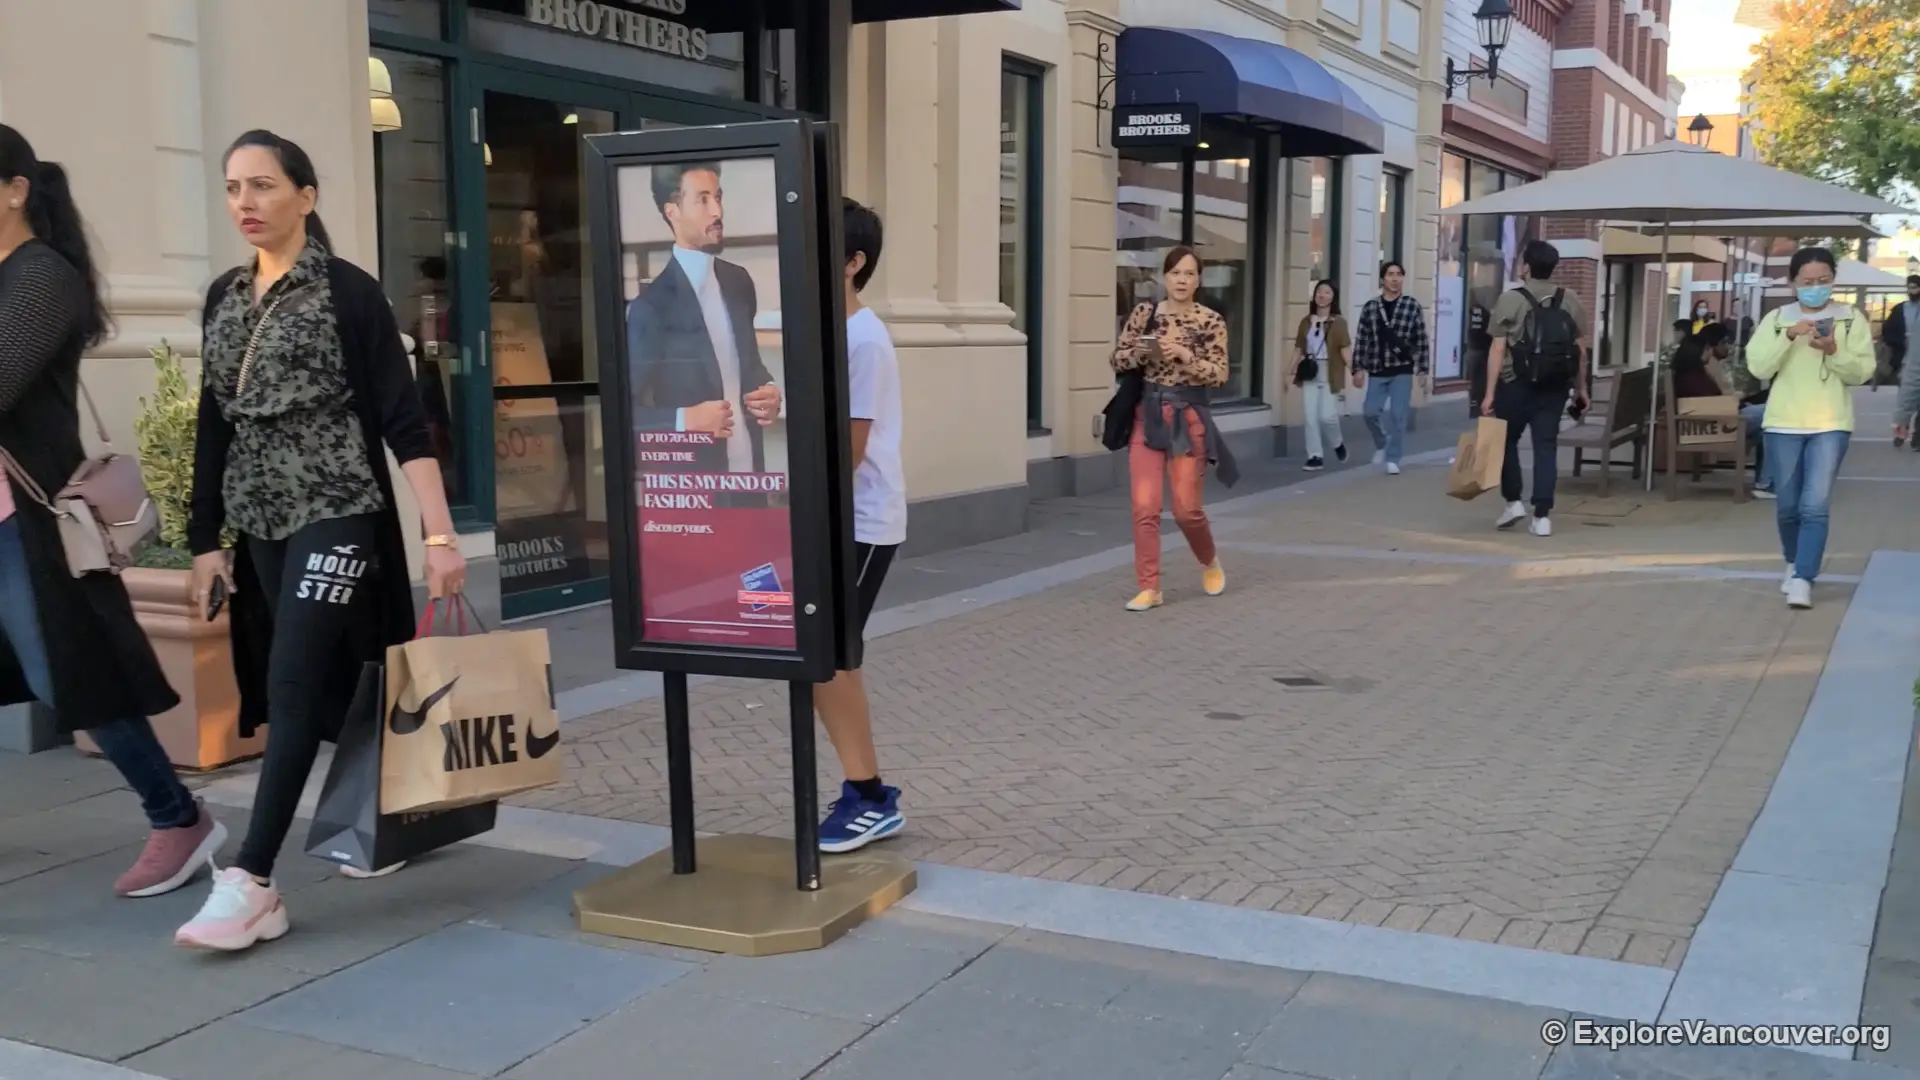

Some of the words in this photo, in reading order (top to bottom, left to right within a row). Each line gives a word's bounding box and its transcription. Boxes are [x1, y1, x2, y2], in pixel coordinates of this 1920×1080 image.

[527, 0, 707, 60] BROTHERS
[1128, 114, 1182, 125] BROOKS
[1119, 125, 1191, 136] BROTHERS
[1680, 420, 1718, 436] NIKE
[640, 432, 654, 443] UP
[653, 432, 669, 443] TO
[641, 451, 670, 462] EVERY
[643, 473, 678, 489] THIS
[679, 474, 693, 489] IS
[694, 475, 718, 490] MY
[720, 475, 759, 491] KIND
[761, 476, 784, 491] OF
[644, 493, 713, 509] FASHION.
[497, 535, 564, 561] BROOKS
[306, 552, 367, 578] HOLLI
[500, 555, 568, 578] BROTHERS
[296, 580, 353, 605] STER
[440, 713, 518, 772] NIKE
